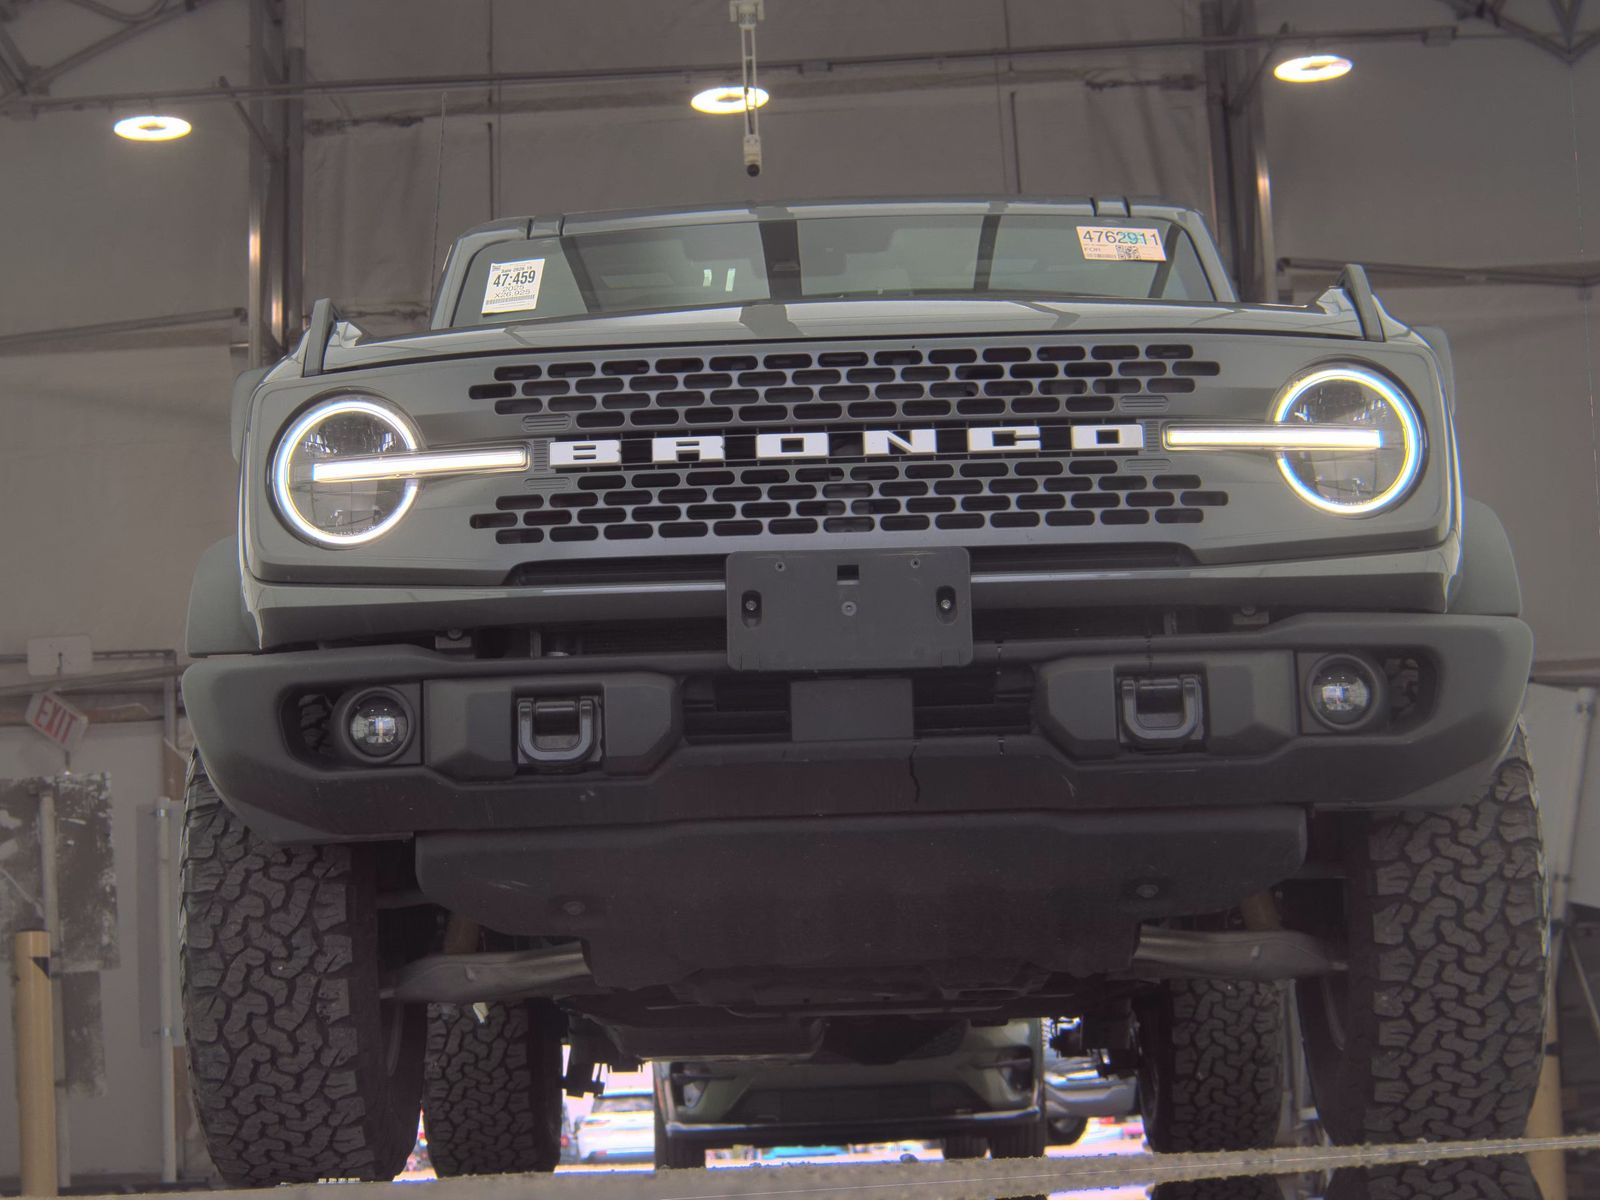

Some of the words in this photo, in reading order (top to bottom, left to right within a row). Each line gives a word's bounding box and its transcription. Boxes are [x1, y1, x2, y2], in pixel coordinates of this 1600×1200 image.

[1083, 231, 1158, 245] 4762911
[493, 270, 535, 287] 47:459
[549, 423, 1144, 469] BRONCO
[34, 696, 79, 744] EXIT
